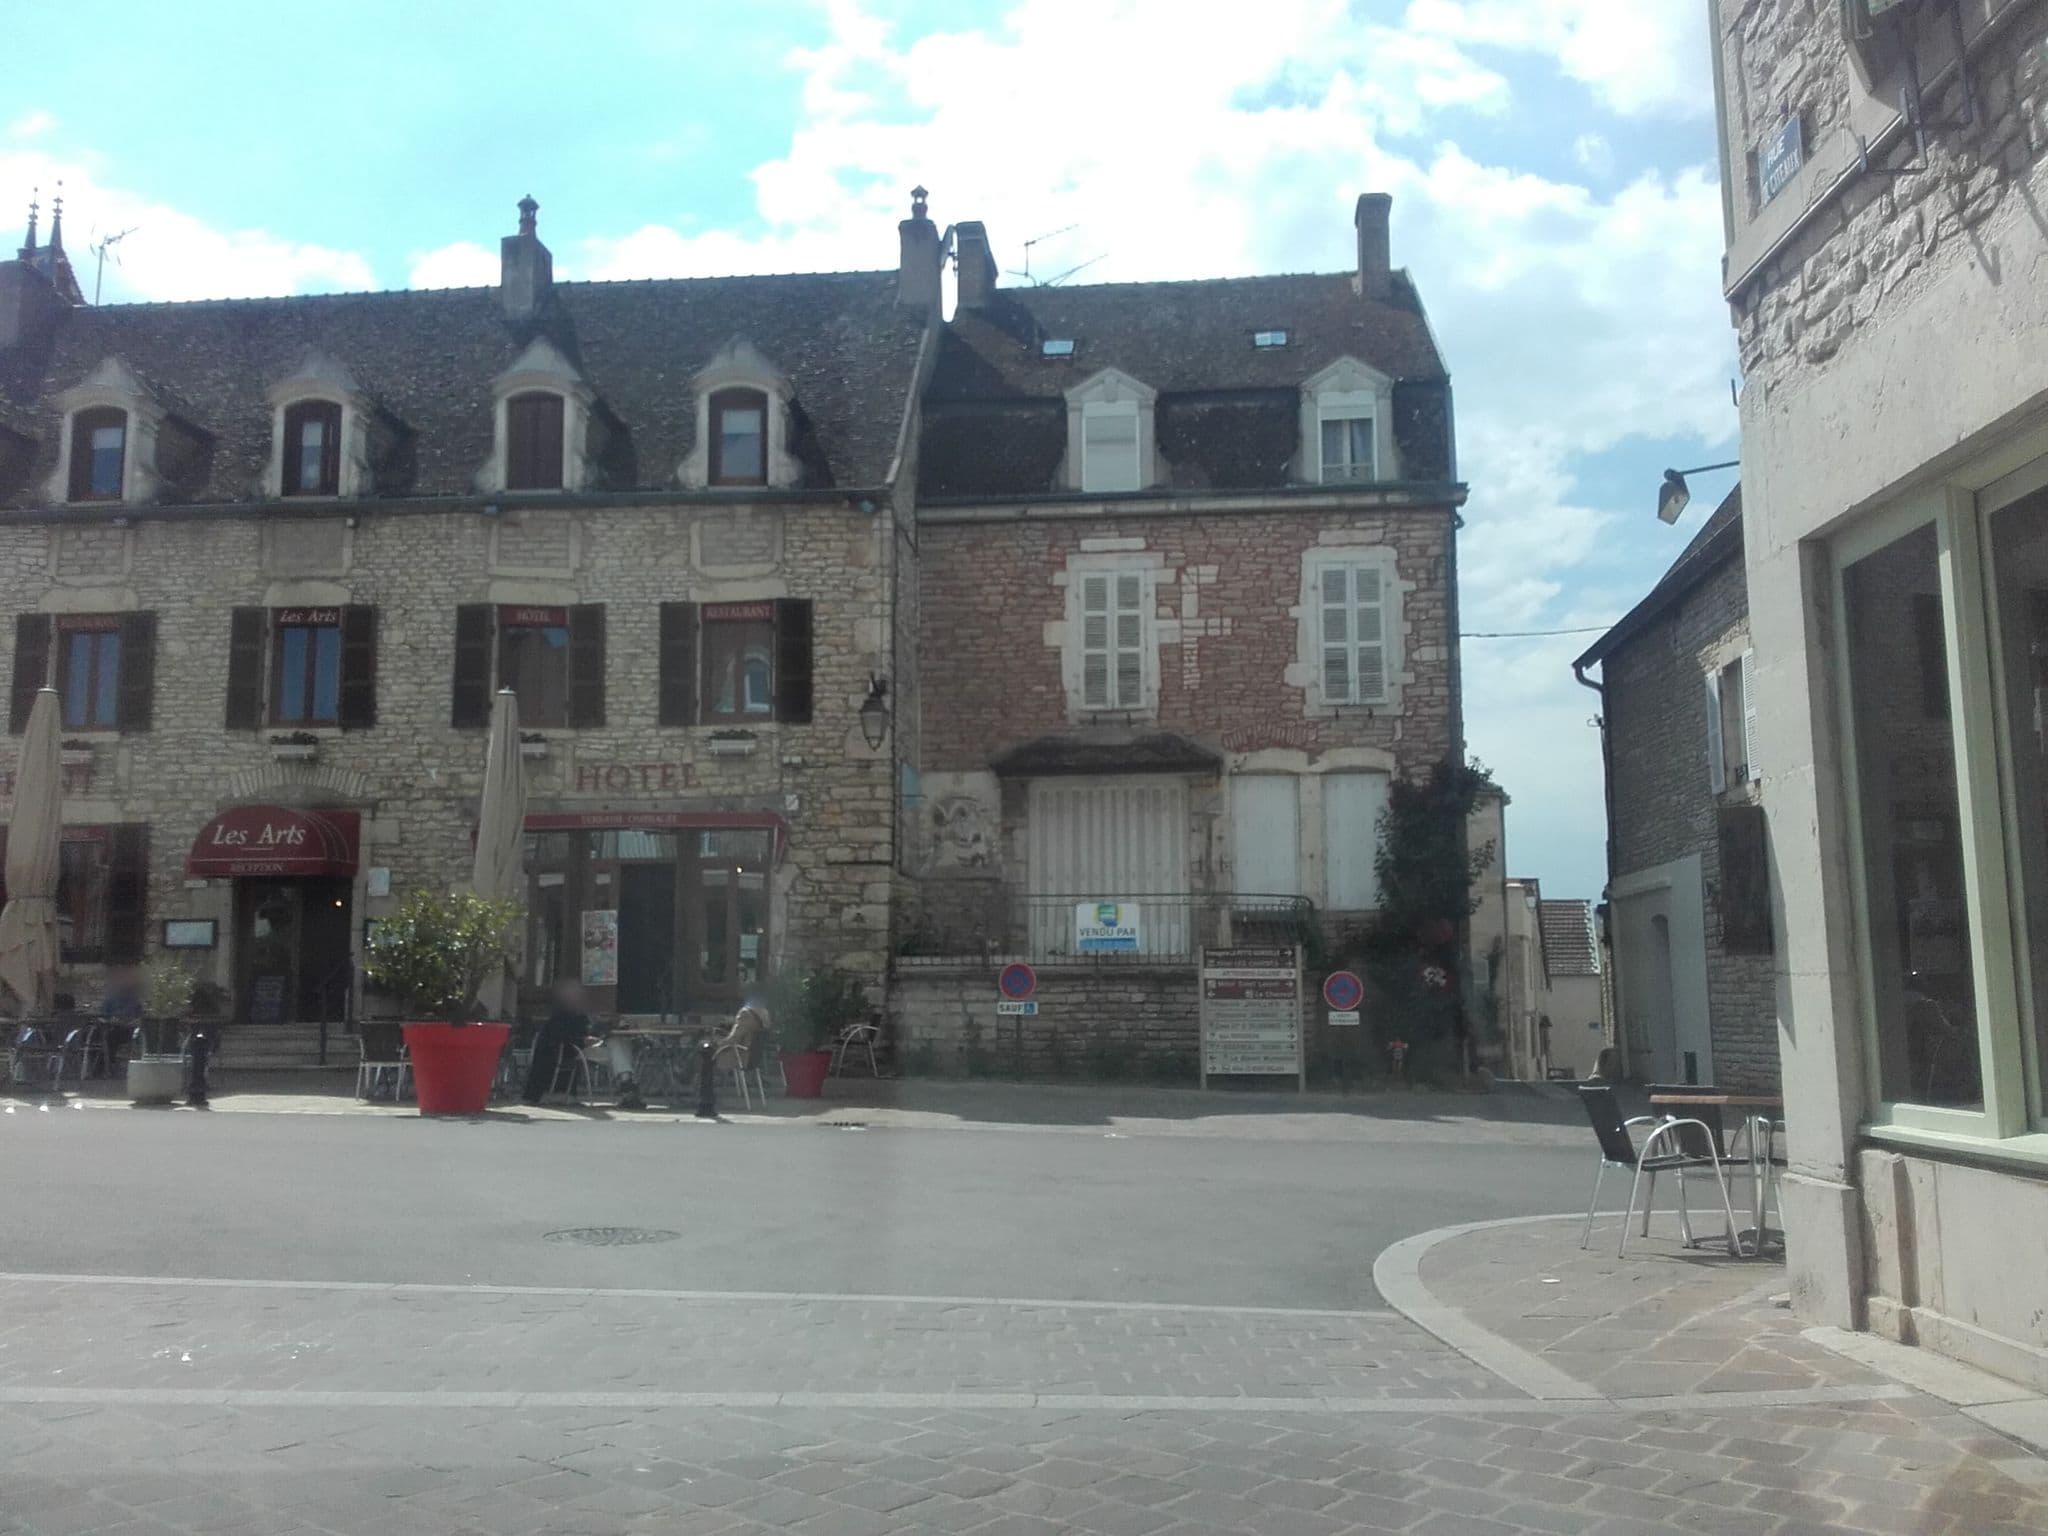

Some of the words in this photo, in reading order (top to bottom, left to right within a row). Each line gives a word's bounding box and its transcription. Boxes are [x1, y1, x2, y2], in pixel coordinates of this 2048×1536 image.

[1767, 135, 1785, 169] RUE
[279, 609, 305, 623] Les
[307, 608, 338, 623] Arts
[706, 604, 771, 620] RESTAURANT
[212, 824, 248, 845] Les
[256, 823, 306, 845] Arts
[1079, 928, 1114, 937] VENDU
[1116, 928, 1136, 937] PAR
